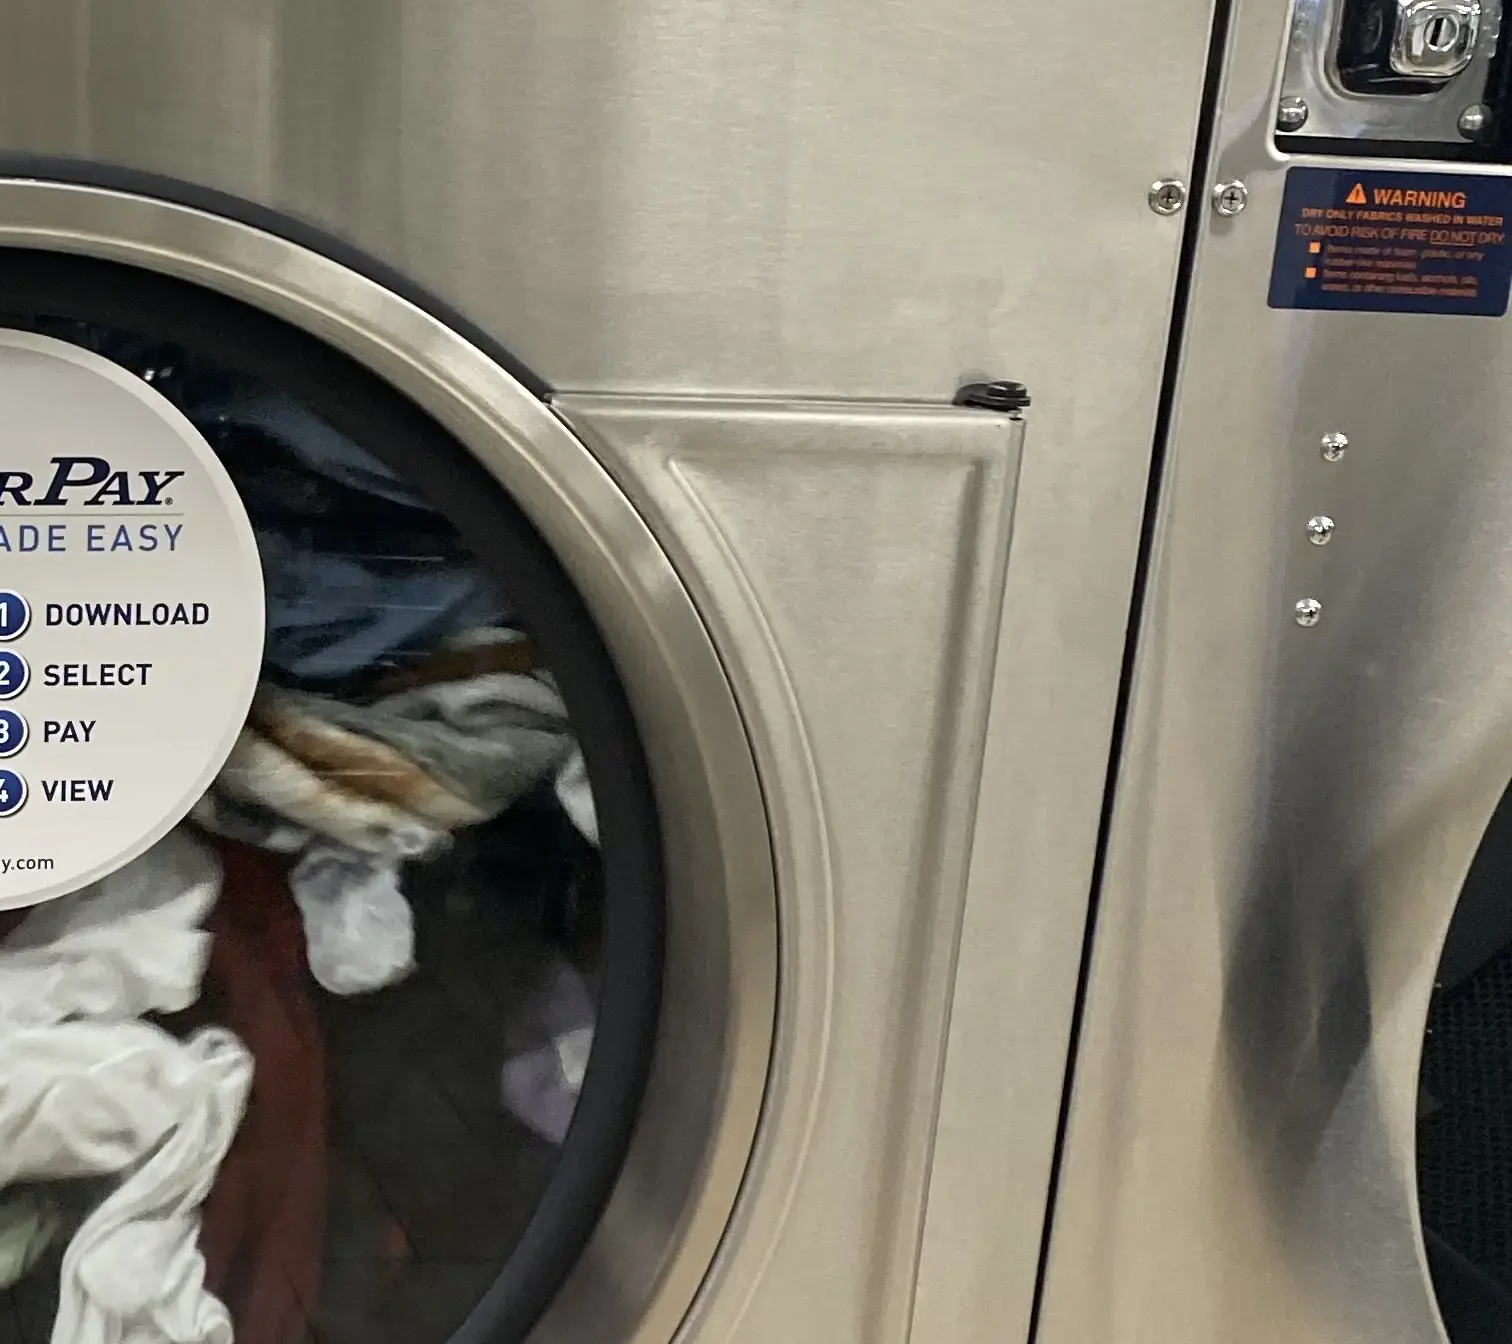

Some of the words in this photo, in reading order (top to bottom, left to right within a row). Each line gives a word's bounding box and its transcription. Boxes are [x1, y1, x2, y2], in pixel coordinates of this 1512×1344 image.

[1373, 188, 1466, 209] WARNING
[1356, 210, 1402, 222] FABRICS
[1294, 223, 1311, 235] TO
[1312, 223, 1349, 236] AVOID
[1351, 225, 1378, 238] RISK
[1381, 226, 1399, 238] OF
[1400, 228, 1429, 240] FIRE
[1430, 229, 1449, 241] DO
[1451, 231, 1477, 243] NOT
[86, 524, 183, 552] EASY
[45, 603, 211, 627] DOWNLOAD
[43, 663, 152, 688] SELECT
[43, 720, 96, 743] PAY
[41, 780, 114, 802] VIEW
